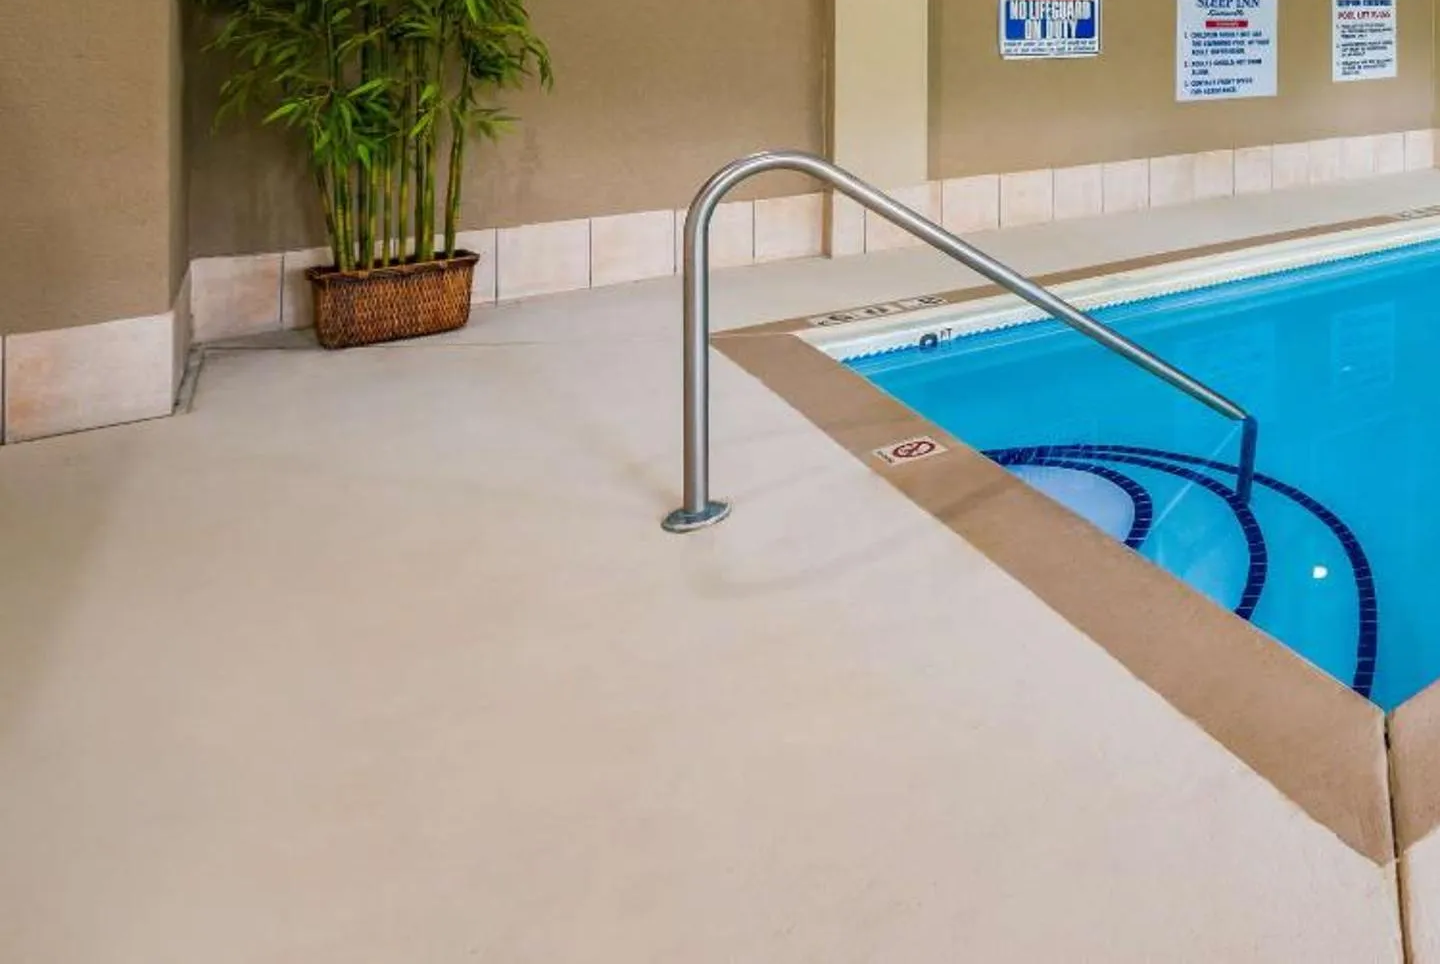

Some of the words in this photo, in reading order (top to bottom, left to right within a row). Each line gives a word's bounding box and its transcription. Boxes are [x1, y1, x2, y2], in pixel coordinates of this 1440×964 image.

[1009, 0, 1026, 20] NO
[1029, 0, 1091, 20] LIFEGUARD
[1046, 19, 1078, 39] DUTY
